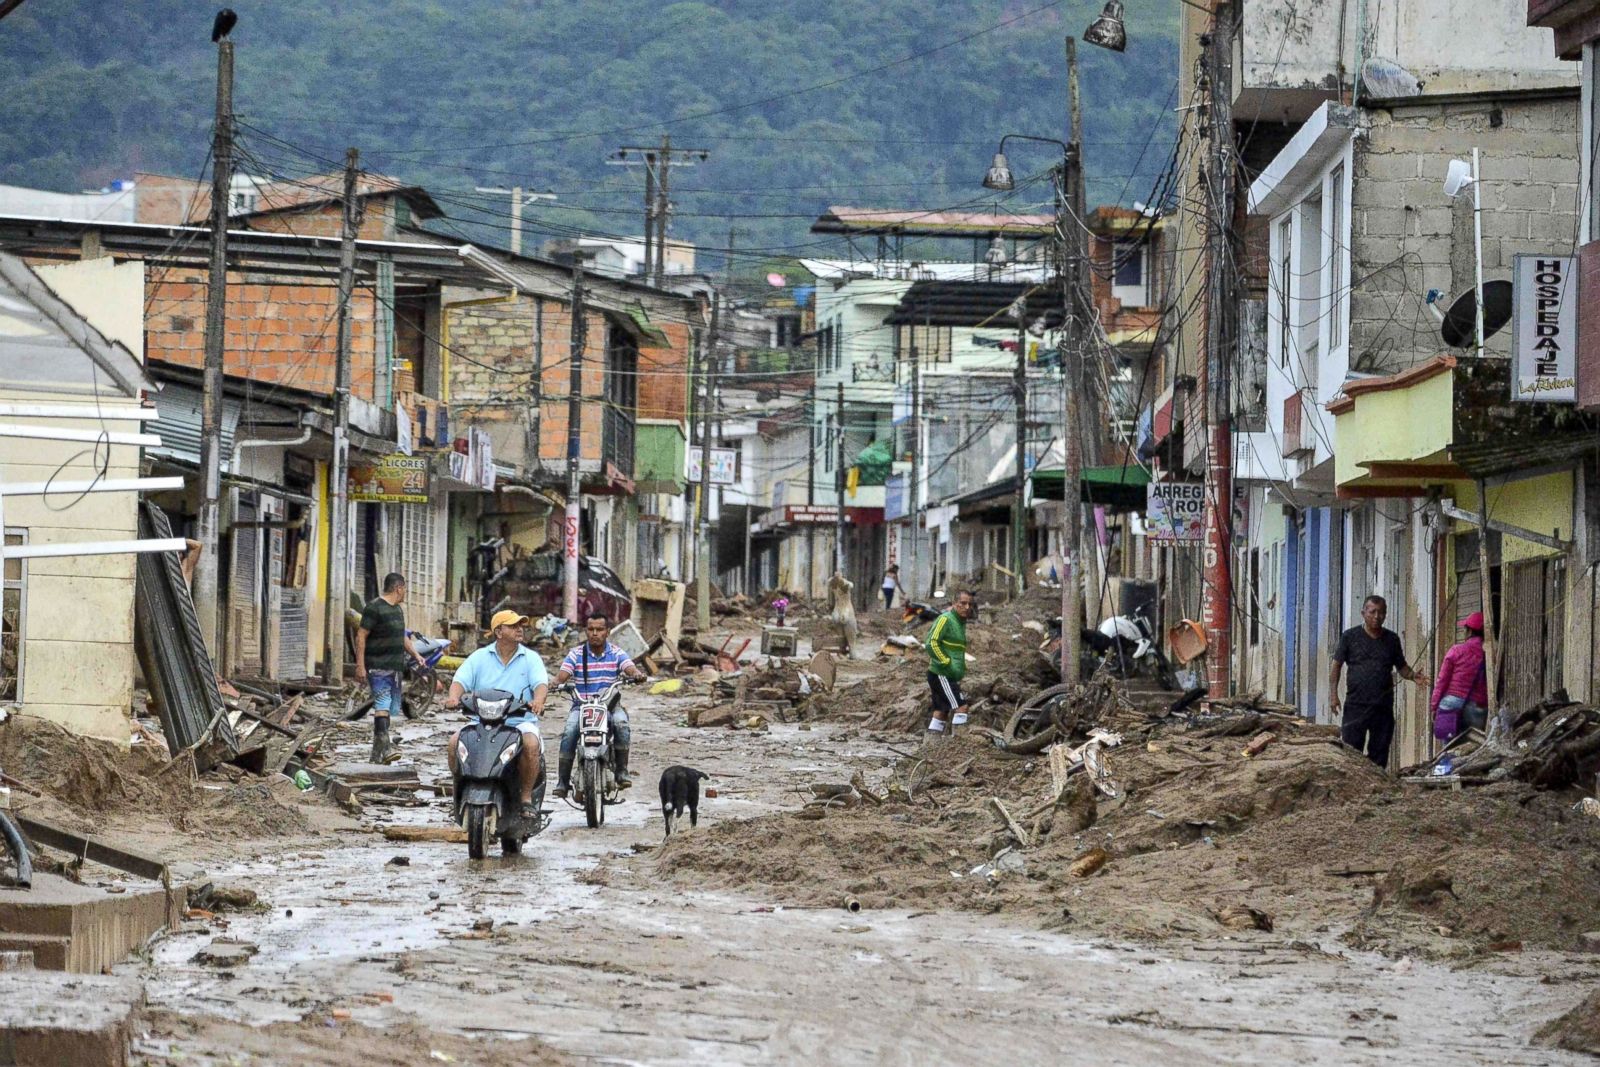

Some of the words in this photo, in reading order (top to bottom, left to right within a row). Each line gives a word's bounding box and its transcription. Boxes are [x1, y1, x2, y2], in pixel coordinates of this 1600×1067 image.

[1534, 260, 1562, 376] HOSPEDAJE
[386, 459, 425, 469] LICORES
[402, 470, 425, 489] 24
[582, 708, 605, 728] 27
